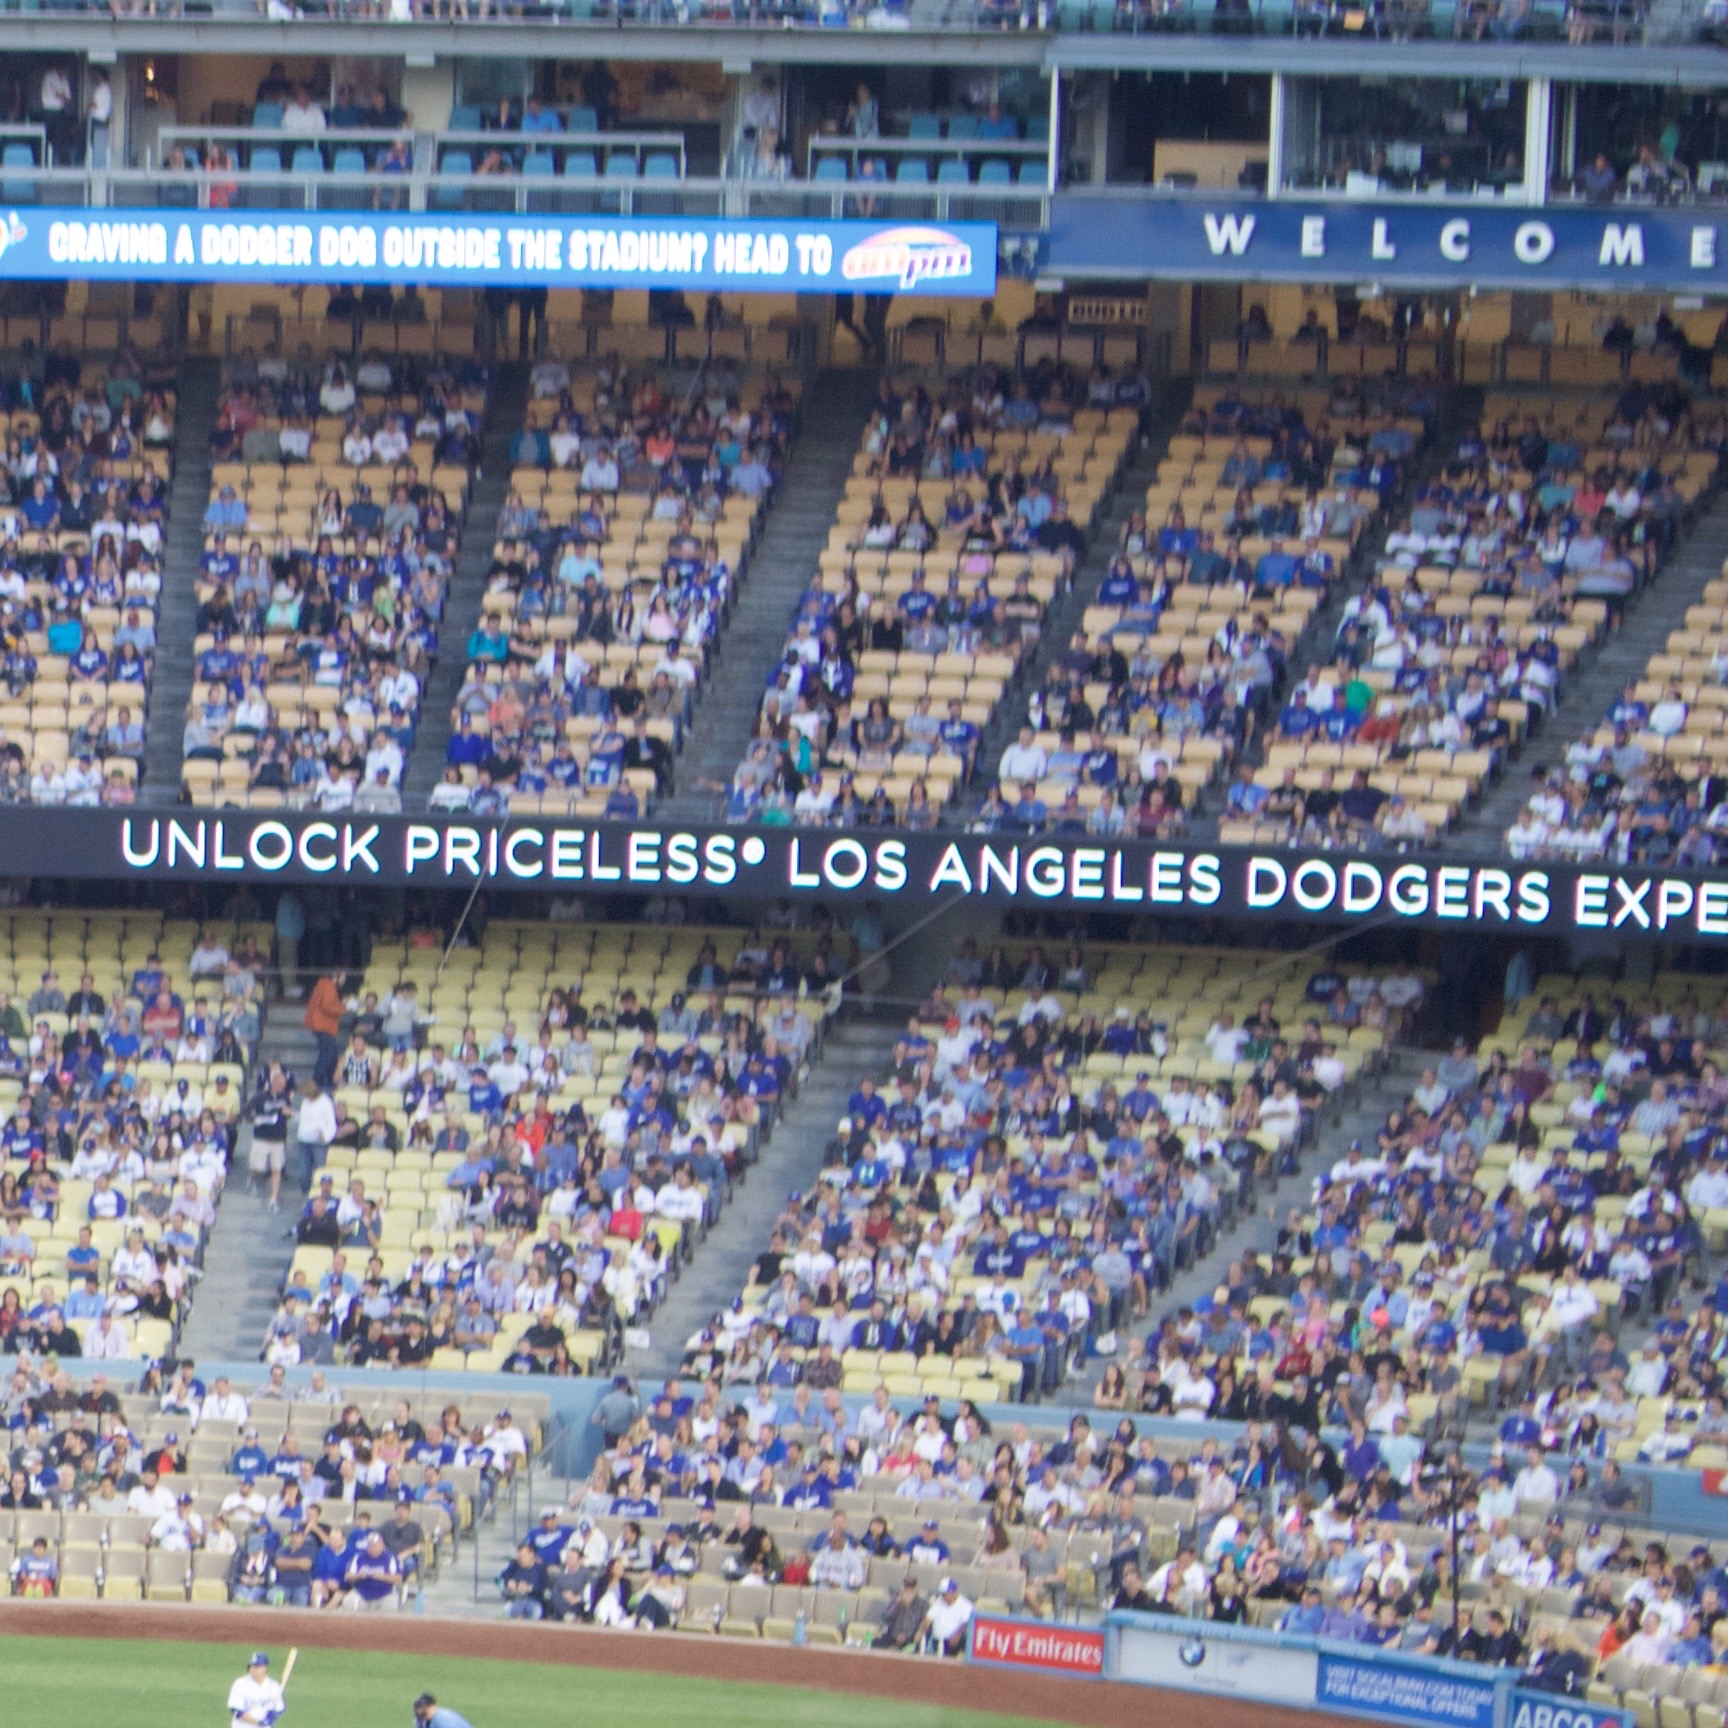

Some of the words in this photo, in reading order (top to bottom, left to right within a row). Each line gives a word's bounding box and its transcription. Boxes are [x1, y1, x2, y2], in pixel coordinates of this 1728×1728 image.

[48, 222, 167, 264] CRAVING
[174, 224, 195, 264] A
[200, 224, 313, 266] DODGER
[319, 226, 377, 267] DOG
[383, 226, 501, 270] OUTSIDE
[507, 229, 563, 270] THE
[568, 230, 708, 274] STADIUM?
[713, 232, 789, 275] HEAD
[795, 235, 833, 276] TO
[1204, 213, 1717, 268] WELCOME
[122, 818, 379, 873] UNLOCK
[788, 837, 908, 892] LOS
[930, 843, 1222, 906] ANGELES
[1247, 857, 1550, 924] DODGERS
[975, 1625, 1011, 1658] Fly
[1013, 1630, 1103, 1666] Emirates
